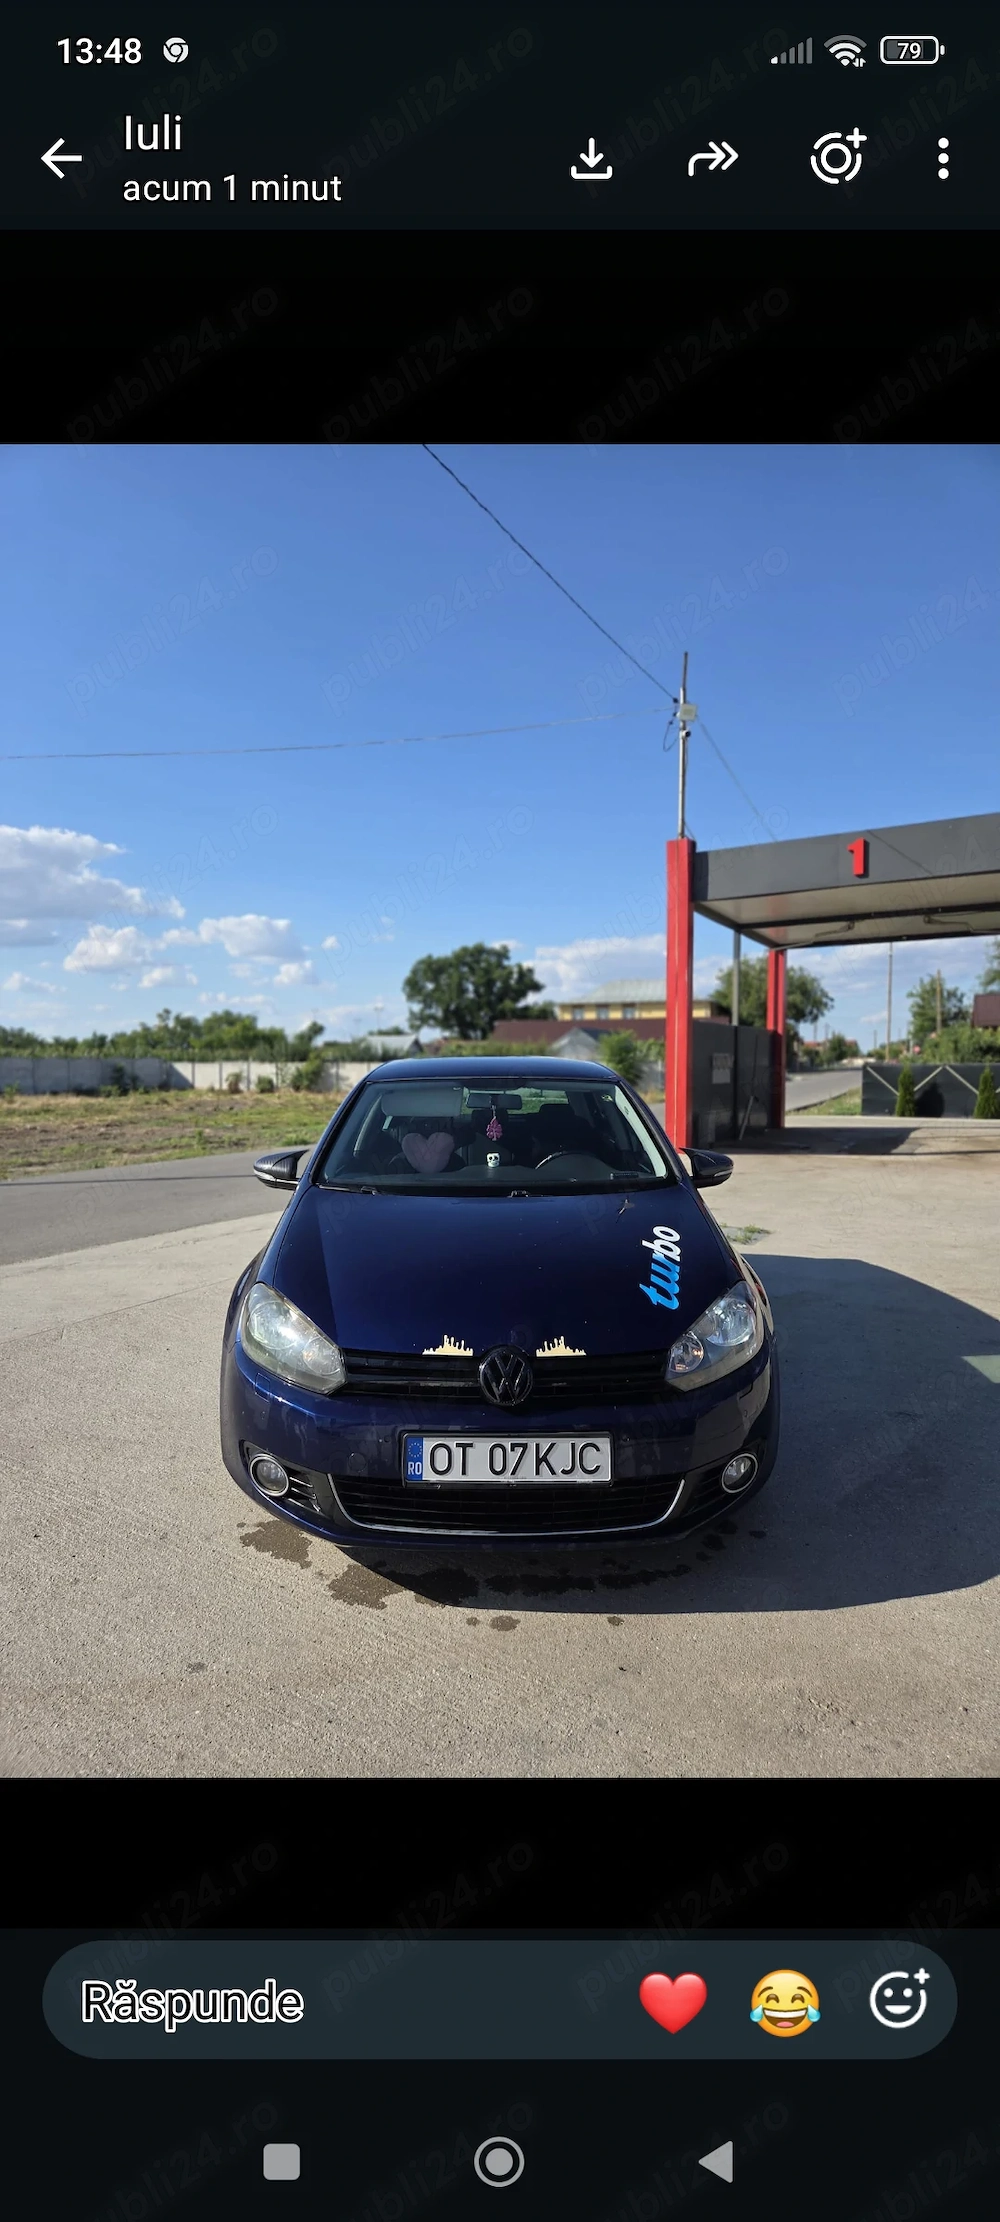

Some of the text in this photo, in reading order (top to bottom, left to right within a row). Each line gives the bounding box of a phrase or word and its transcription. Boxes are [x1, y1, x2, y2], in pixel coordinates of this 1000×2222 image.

[57, 37, 142, 64] 13:48
[897, 42, 921, 60] 79
[123, 174, 342, 202] acum 1 minut
[847, 837, 866, 876] 1
[639, 1225, 681, 1310] turbo
[407, 1461, 422, 1476] RO
[429, 1442, 474, 1476] OT
[82, 1978, 304, 2034] Răspunde
